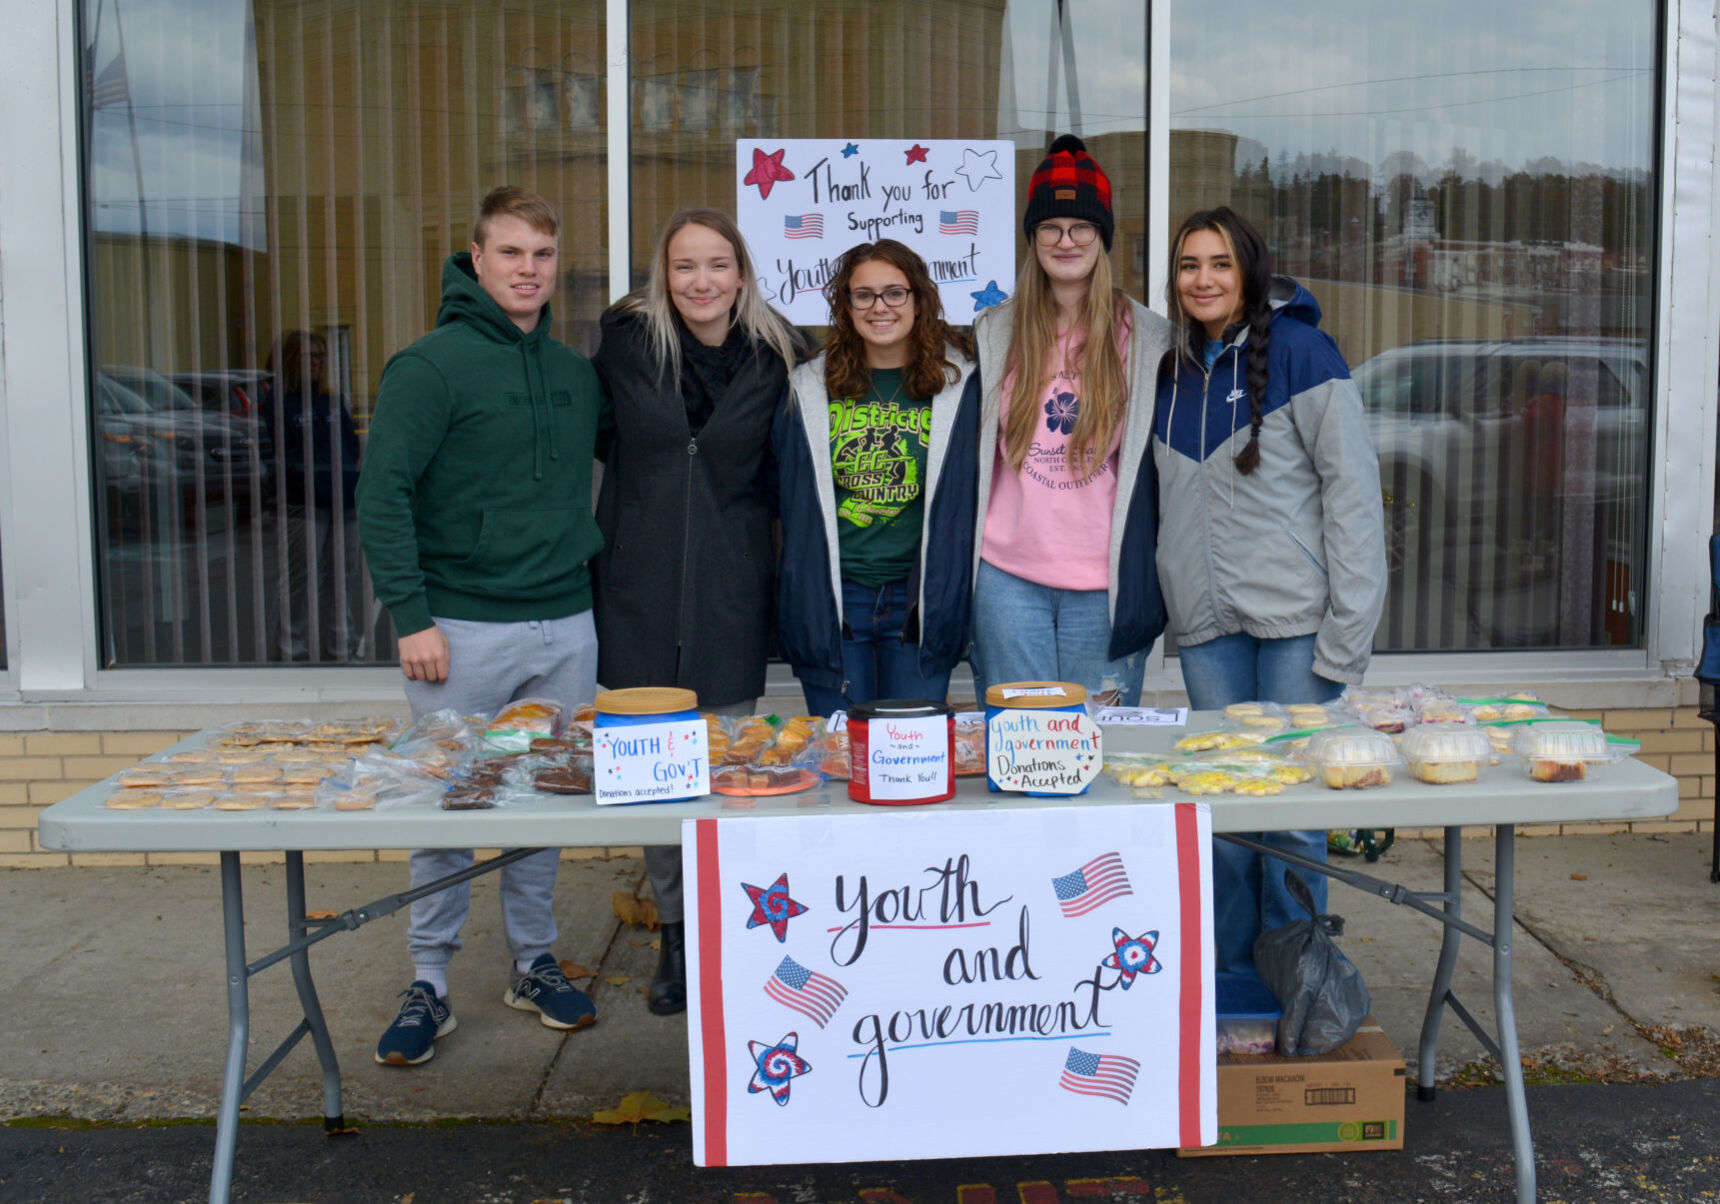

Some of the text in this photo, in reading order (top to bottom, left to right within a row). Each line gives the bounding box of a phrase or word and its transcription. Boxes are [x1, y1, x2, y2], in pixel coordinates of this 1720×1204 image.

[804, 157, 956, 213] Thank you for
[847, 208, 924, 241] Supporting
[829, 398, 919, 442] District
[1028, 442, 1066, 457] Sunset
[1034, 456, 1061, 465] NORTH
[836, 473, 884, 488] CROSS
[1023, 461, 1056, 490] COASTAL
[886, 723, 923, 740] Youth
[991, 714, 1040, 752] youth
[1047, 713, 1083, 735] and
[607, 736, 661, 759] YOUTH
[872, 749, 946, 765] Government
[1005, 731, 1101, 767] government
[996, 755, 1066, 776] Donations
[878, 773, 912, 783] Thank
[1021, 768, 1082, 789] Accepted
[599, 788, 633, 799] Donations
[830, 853, 1014, 967] youth
[943, 904, 1042, 986] and
[852, 965, 1124, 1108] government
